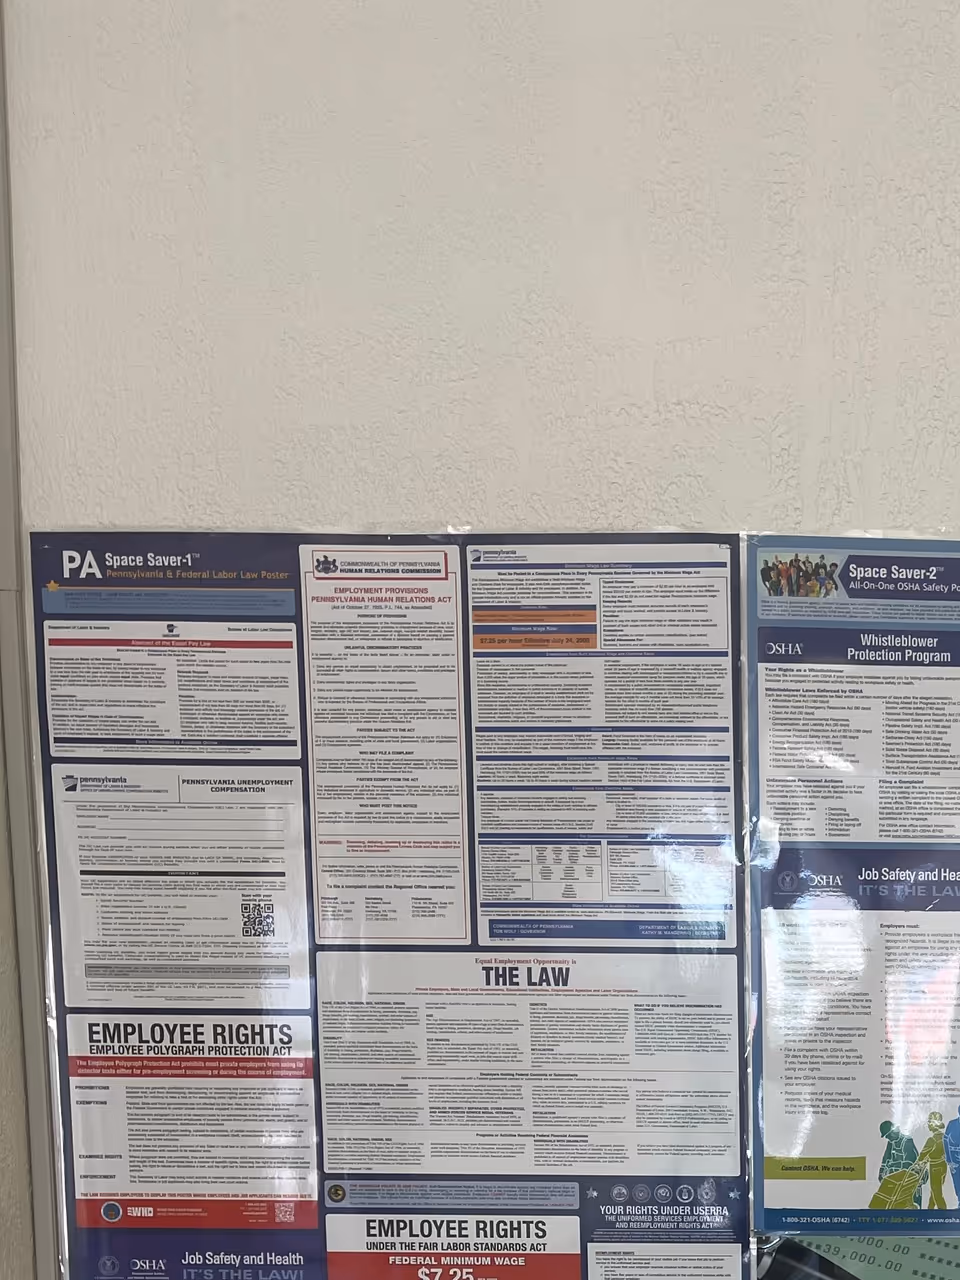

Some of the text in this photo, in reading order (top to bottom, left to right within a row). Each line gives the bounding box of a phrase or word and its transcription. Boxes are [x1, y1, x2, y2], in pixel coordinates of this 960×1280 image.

[63, 550, 102, 578] PA
[106, 553, 199, 568] Space Saver-1™
[107, 570, 163, 578] Pennsylvania
[167, 570, 173, 578] &
[176, 570, 209, 578] Federal
[850, 564, 943, 581] Space Saver-2™
[333, 587, 428, 595] EMPLOYMENT PROVISIONS
[850, 581, 895, 590] All-On-One
[898, 582, 920, 590] OSHA
[923, 583, 948, 593] Safety
[861, 634, 938, 646] Whistleblower
[848, 648, 950, 664] Protection Program
[475, 958, 493, 966] Equal
[494, 958, 531, 966] Employment
[482, 967, 570, 986] THE LAW
[88, 1023, 292, 1045] EMPLOYEE RIGHTS
[88, 1044, 292, 1056] EMPLOYEE POLYGRAPH PROTECTION ACT
[600, 1205, 728, 1216] YOUR RIGHTS UNDER USERRA
[366, 1220, 546, 1238] EMPLOYEE RIGHTS
[365, 1242, 548, 1252] UNDER THE FAIR LABOR STANDARDS ACT
[182, 1252, 303, 1266] Job Safety and Health
[494, 1257, 525, 1265] WAGE
[184, 1269, 302, 1280] IT'S THE LAW!
